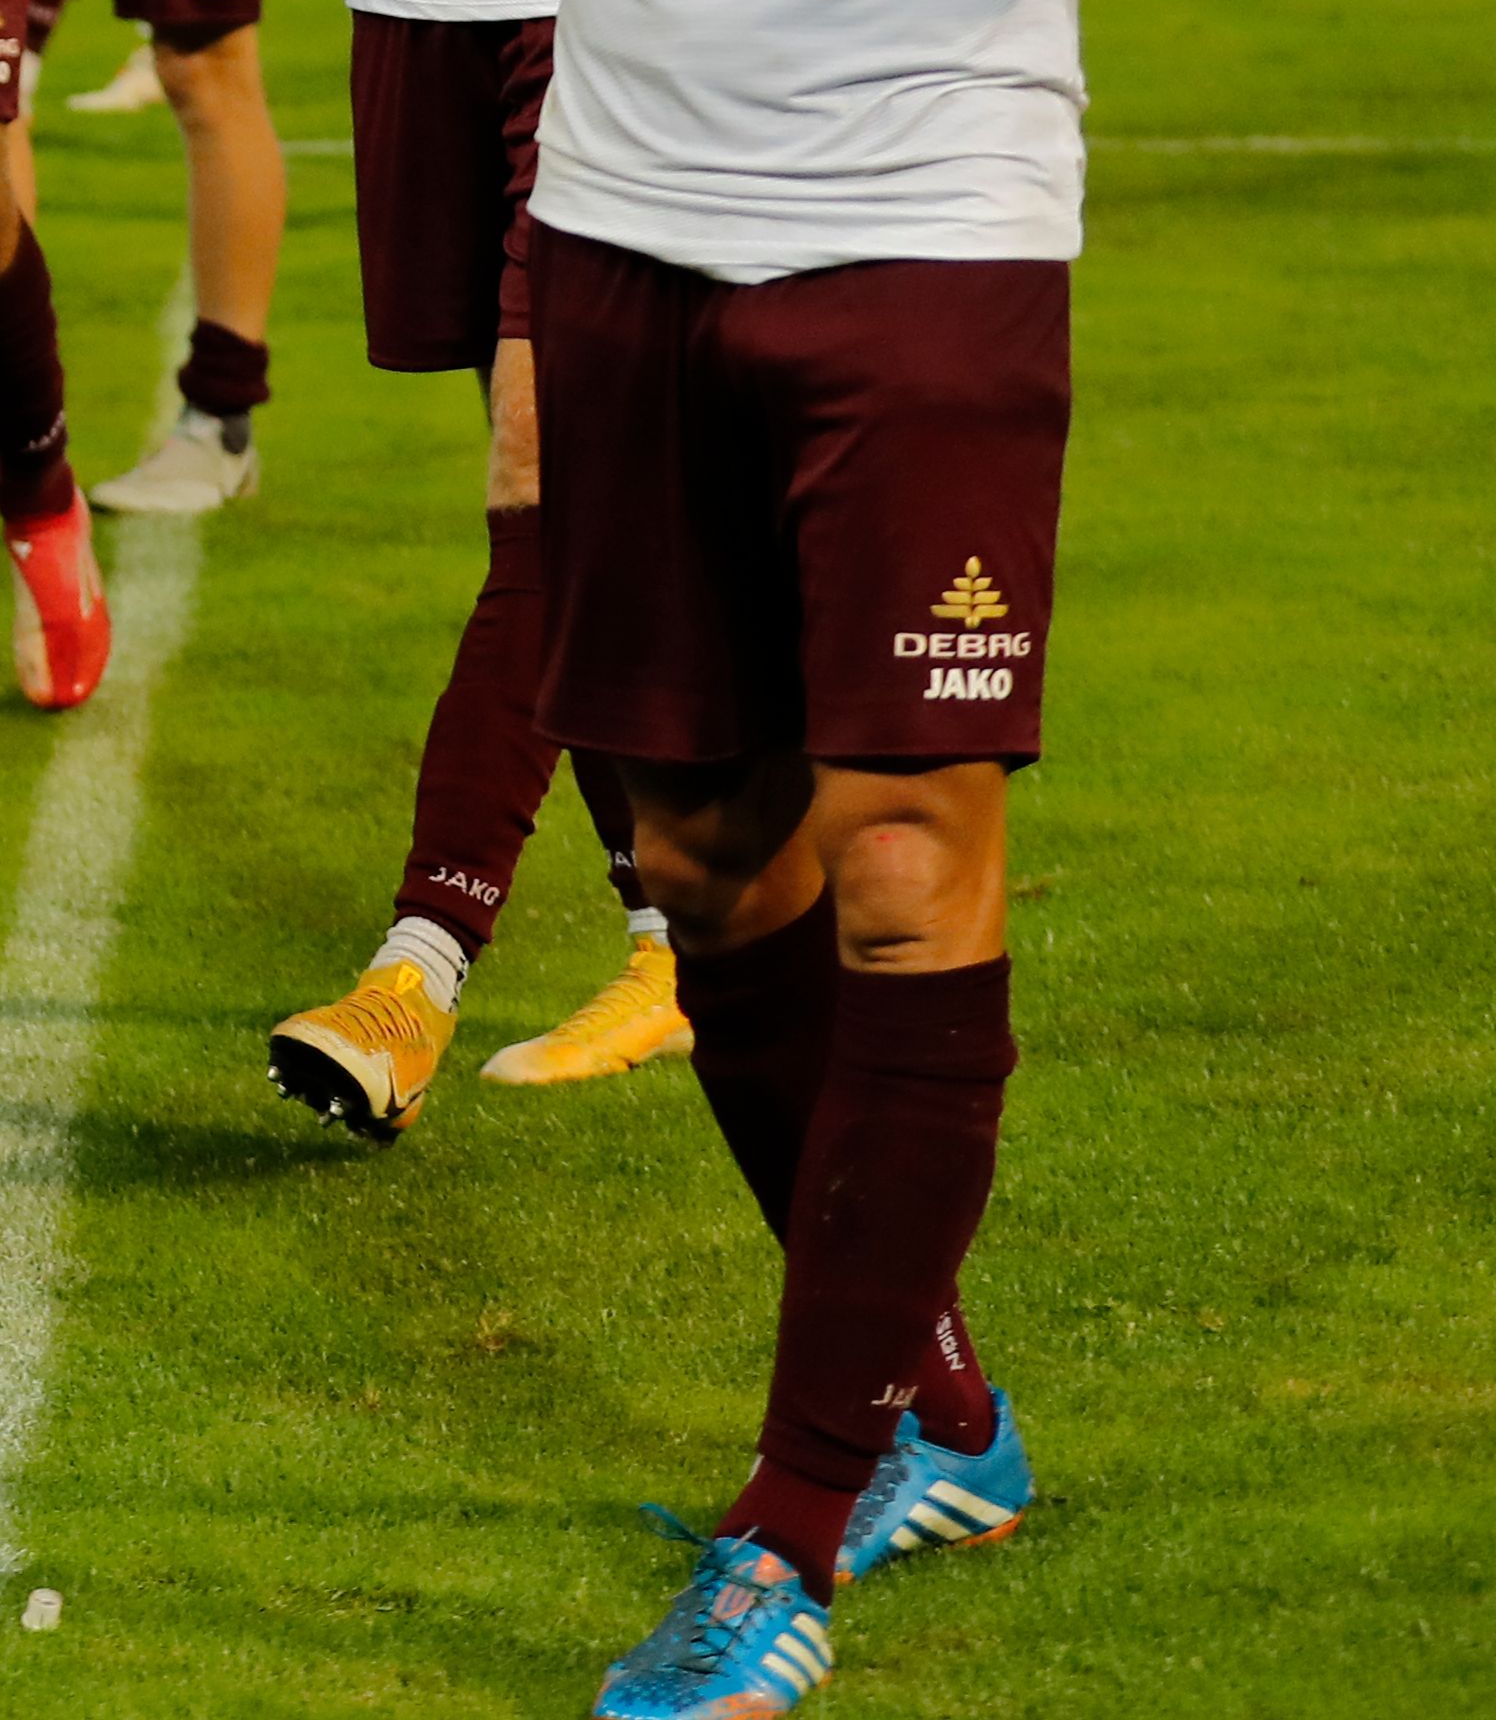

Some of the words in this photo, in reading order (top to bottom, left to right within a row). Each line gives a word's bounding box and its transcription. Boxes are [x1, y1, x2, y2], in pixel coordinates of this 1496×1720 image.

[894, 632, 1032, 659] DEBAG
[923, 667, 1014, 701] JAKO
[428, 866, 500, 907] JAKO
